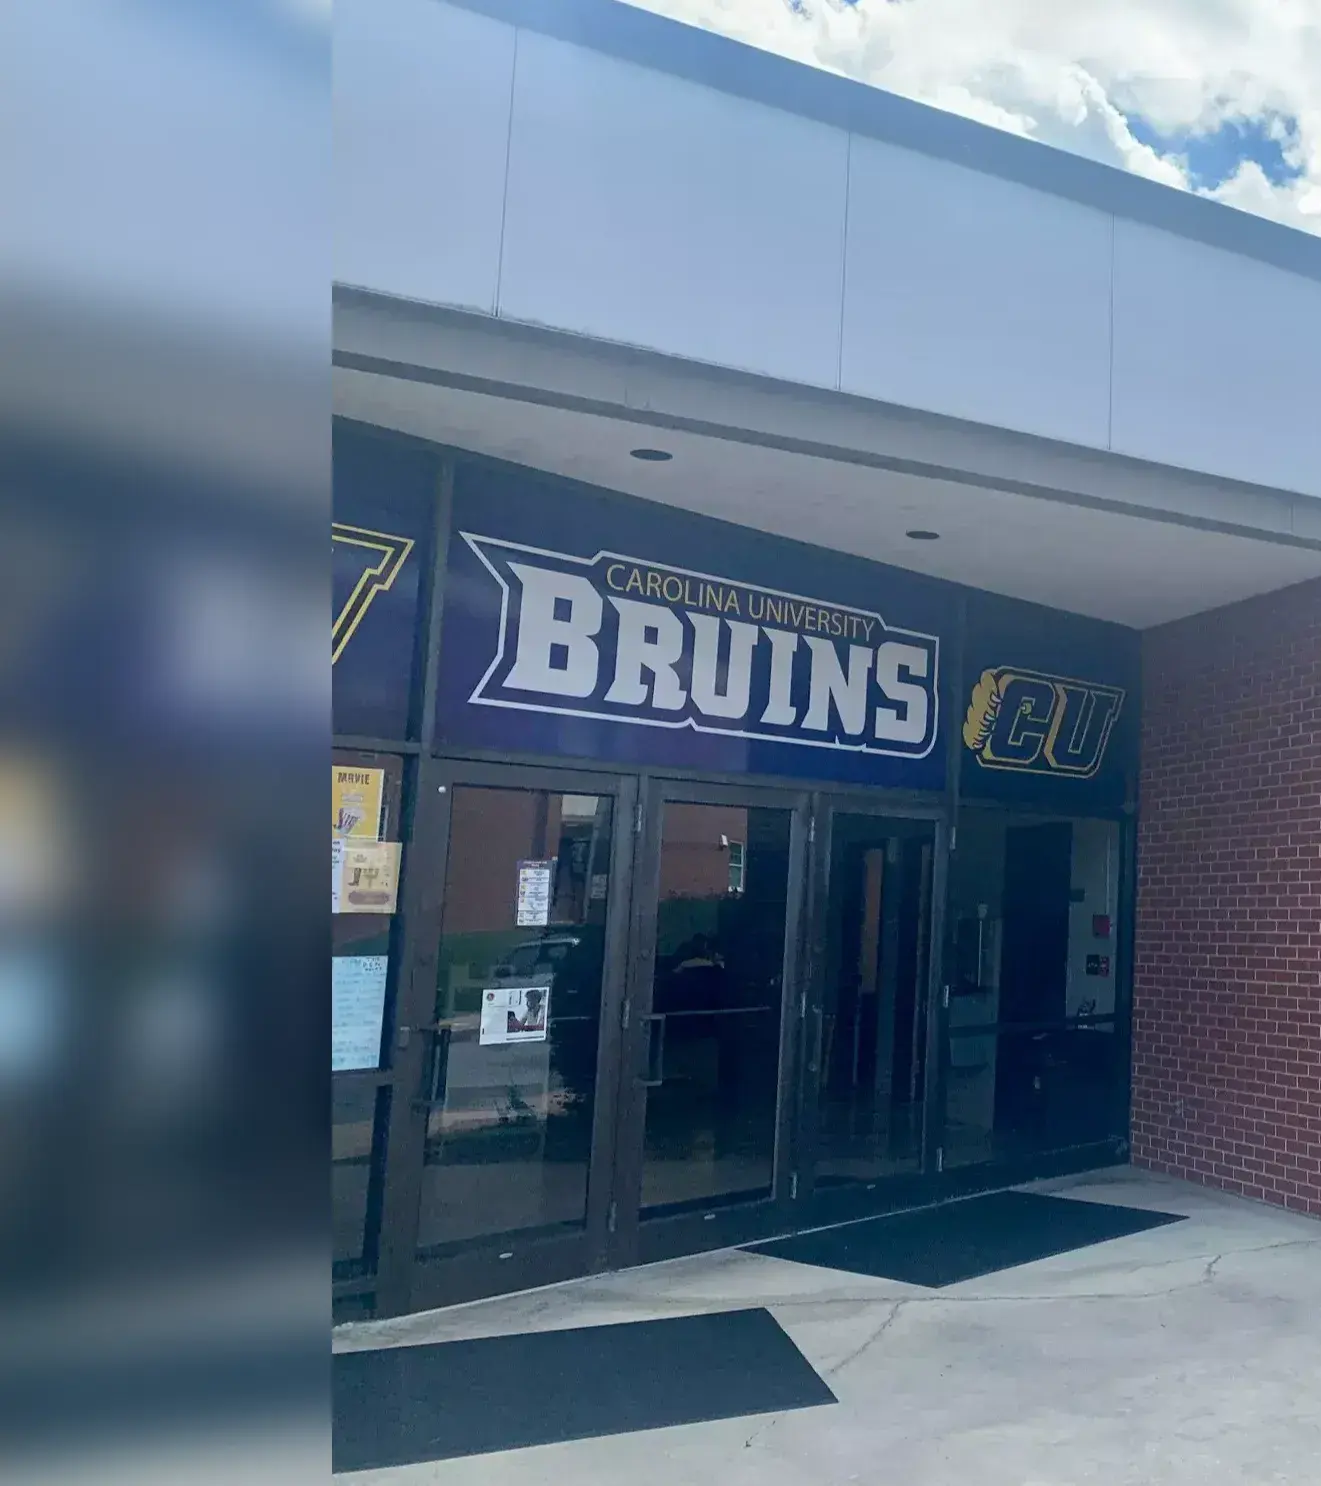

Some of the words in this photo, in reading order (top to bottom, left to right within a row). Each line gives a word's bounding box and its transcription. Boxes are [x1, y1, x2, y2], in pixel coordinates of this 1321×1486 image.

[606, 564, 740, 615] CAROLINA
[748, 598, 875, 641] UNIVERSITY
[502, 561, 928, 743] BRUINS
[982, 675, 1119, 771] CU
